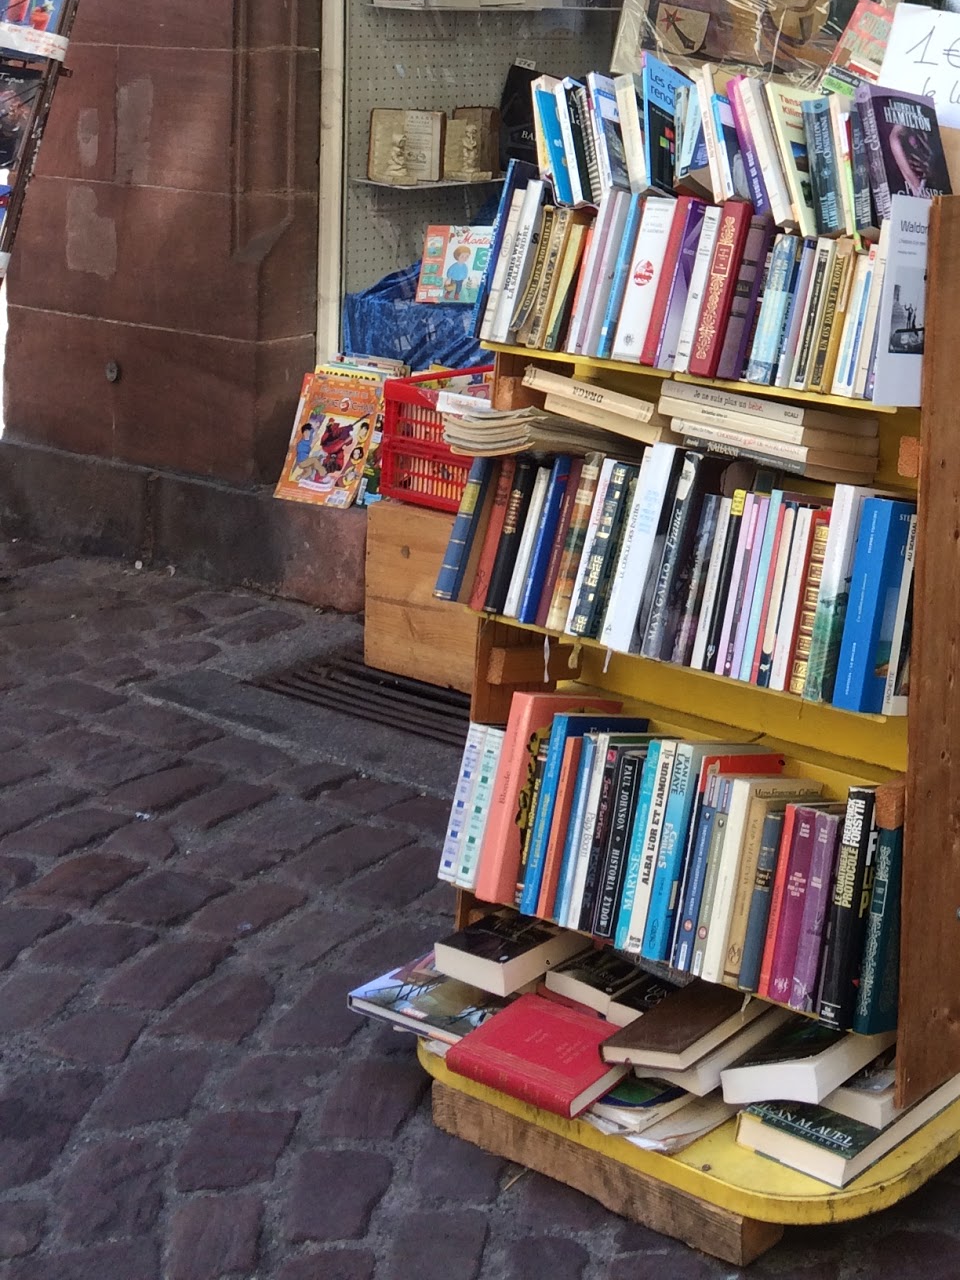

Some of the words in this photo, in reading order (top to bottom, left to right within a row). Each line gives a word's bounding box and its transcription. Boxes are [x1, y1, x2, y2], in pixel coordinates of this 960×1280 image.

[883, 106, 932, 132] HAMILTON
[812, 121, 823, 153] PAPILLON
[825, 191, 839, 227] HAMILTON
[858, 187, 872, 223] HAMILTON
[508, 223, 531, 288] SALAMANDRE
[534, 220, 554, 262] MOUCHES
[503, 255, 517, 291] MORRIS
[511, 231, 523, 255] WEST
[530, 261, 543, 281] DES
[507, 288, 514, 299] LA
[522, 281, 537, 311] COMME
[828, 289, 837, 301] LE
[823, 301, 835, 324] DANS
[818, 339, 827, 351] UN
[820, 325, 830, 337] OS
[693, 389, 701, 398] Je
[710, 393, 723, 402] suis
[723, 396, 738, 408] plus
[738, 400, 747, 408] un
[647, 610, 660, 641] MAX
[654, 561, 671, 607] GALLO
[665, 507, 683, 550] France
[621, 764, 633, 788] PAUL
[670, 752, 684, 794] LAHAYE
[680, 756, 689, 777] JEAN
[498, 770, 511, 804] Blonde
[653, 761, 669, 807] L'AMOUR
[678, 778, 686, 796] LUC
[583, 811, 595, 831] Papy
[595, 801, 607, 839] Burton
[614, 789, 630, 830] JOHNSON
[651, 809, 661, 825] ET
[841, 798, 856, 845] FREDERICK
[849, 799, 865, 847] FORSYTH
[580, 832, 591, 857] Boom
[647, 827, 658, 850] L'OR
[657, 822, 673, 868] FAMILLES
[666, 831, 677, 855] CENT
[605, 848, 620, 891] HISTORIA
[622, 852, 641, 911] MARYSE
[641, 853, 654, 885] ALBA
[840, 847, 859, 907] PROTOCOLE
[833, 894, 842, 905] LE
[756, 1099, 795, 1122] JEAN
[809, 1121, 854, 1146] AUEL
